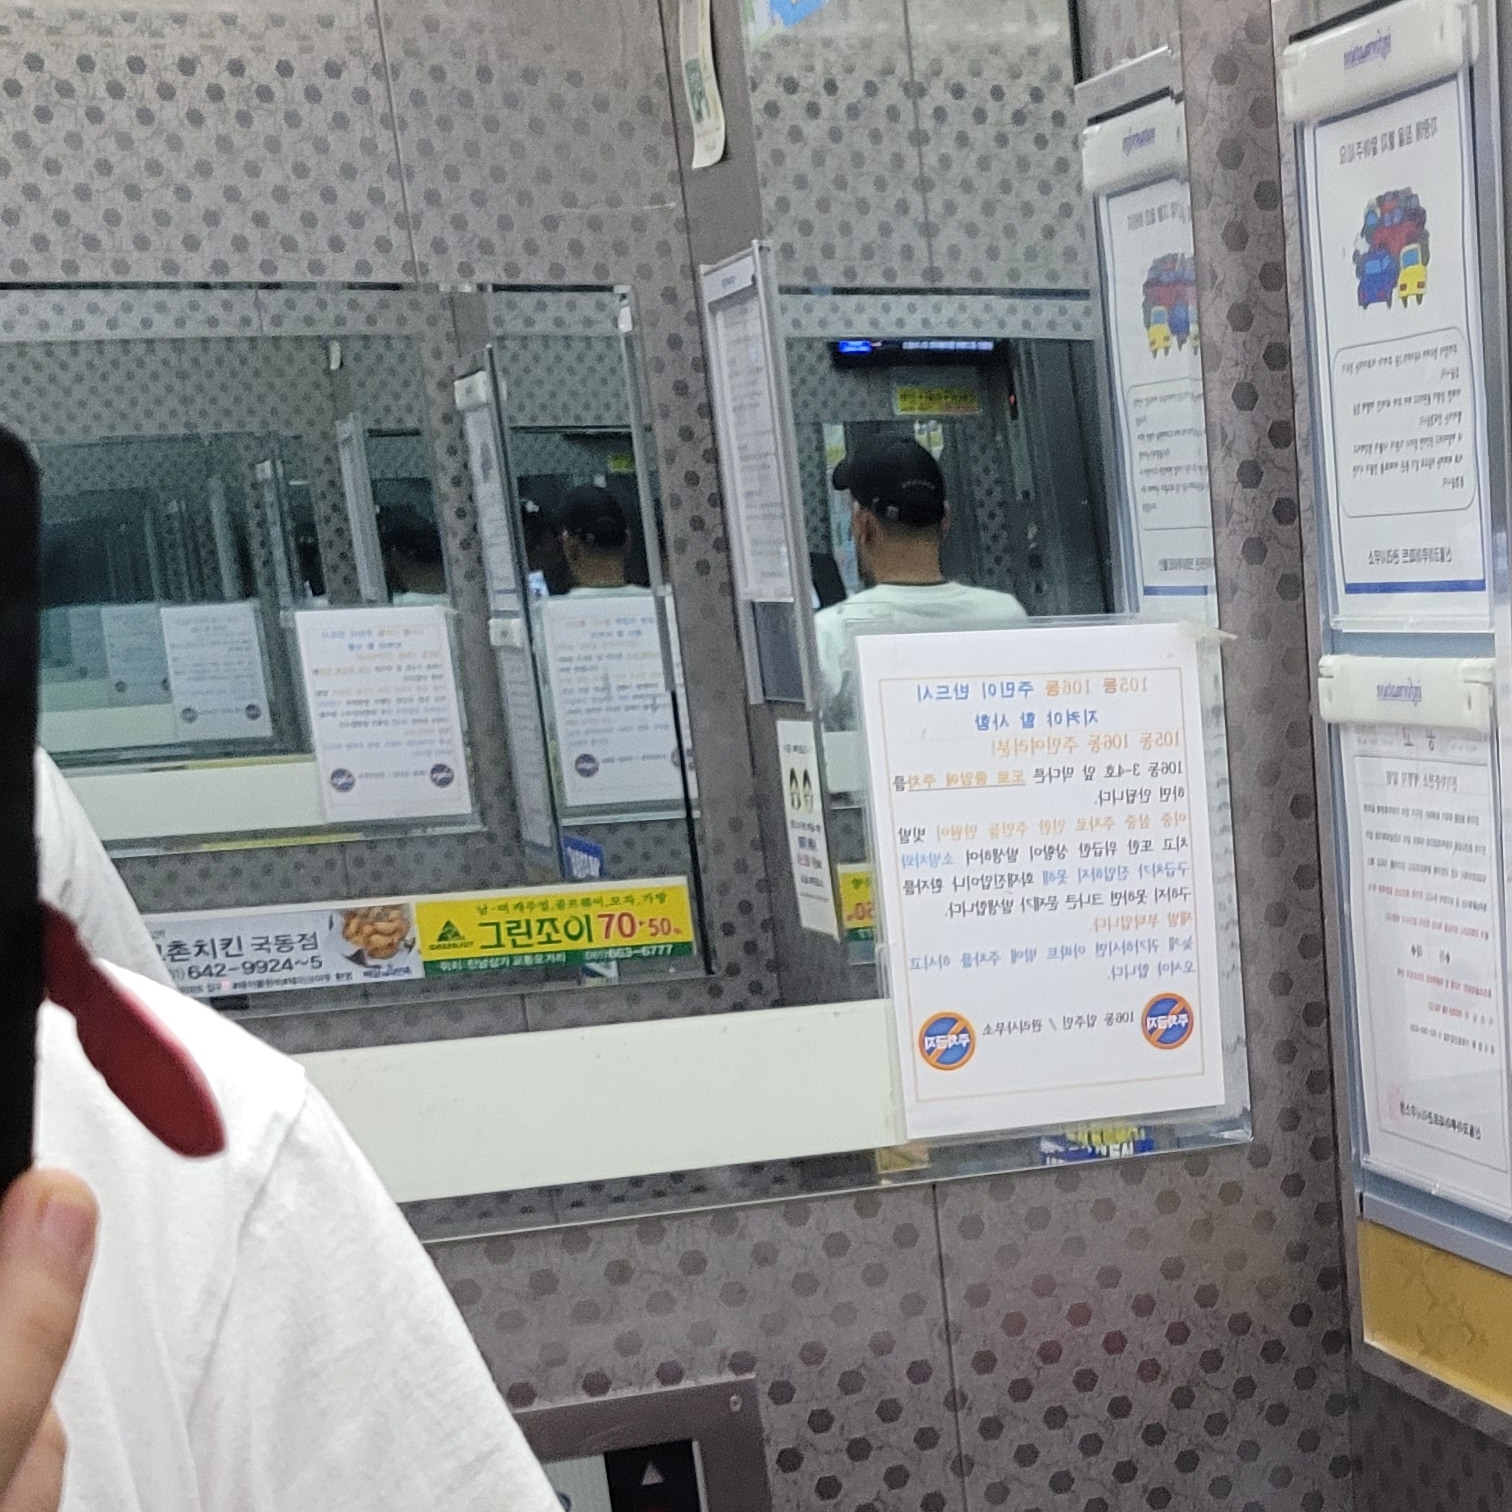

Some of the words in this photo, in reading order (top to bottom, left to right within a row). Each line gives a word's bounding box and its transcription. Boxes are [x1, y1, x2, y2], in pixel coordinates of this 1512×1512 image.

[155, 934, 243, 963] 촌치킨
[250, 930, 318, 955] 국동점
[477, 914, 592, 950] 그린조이
[187, 955, 322, 979] 642-9924~5
